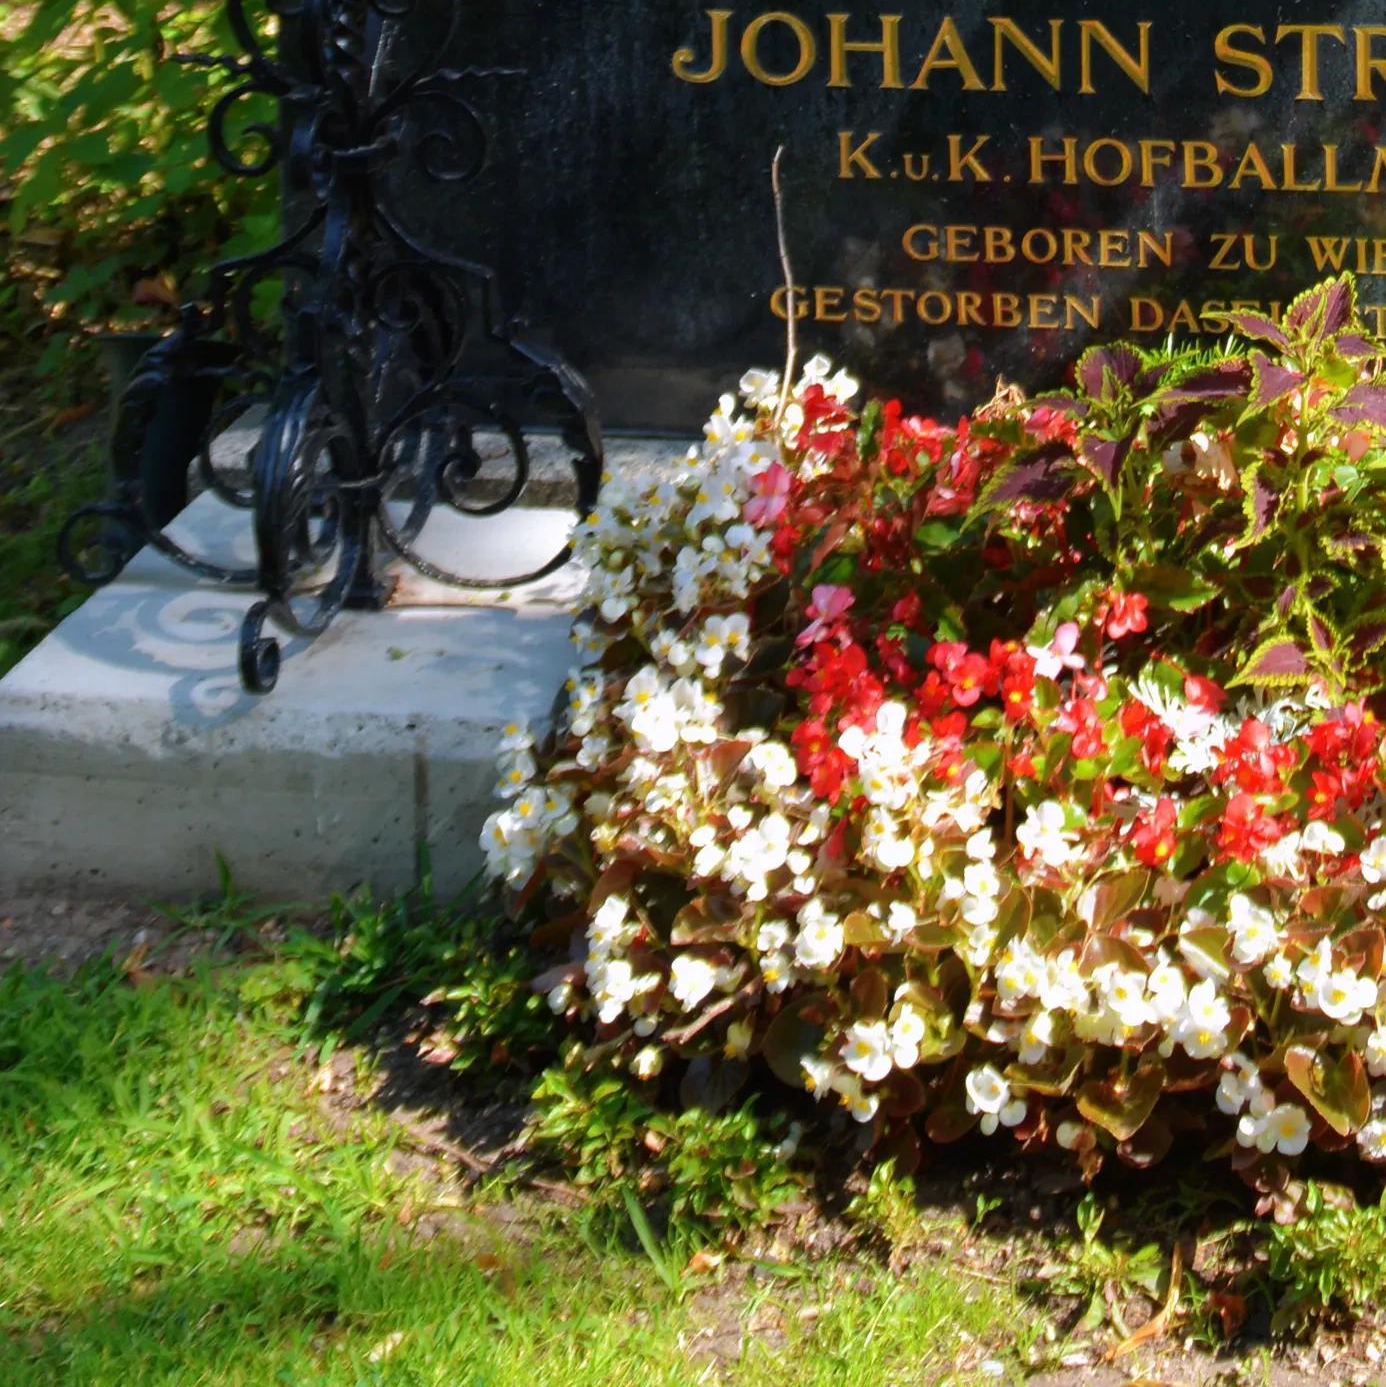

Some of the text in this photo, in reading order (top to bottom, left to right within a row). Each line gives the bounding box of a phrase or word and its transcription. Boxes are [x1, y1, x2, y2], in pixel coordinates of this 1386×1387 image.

[671, 9, 1152, 95] JOHANN
[902, 224, 1176, 269] GEBOREN
[1209, 233, 1278, 271] ZU
[769, 284, 1103, 331] GESTORBEN
